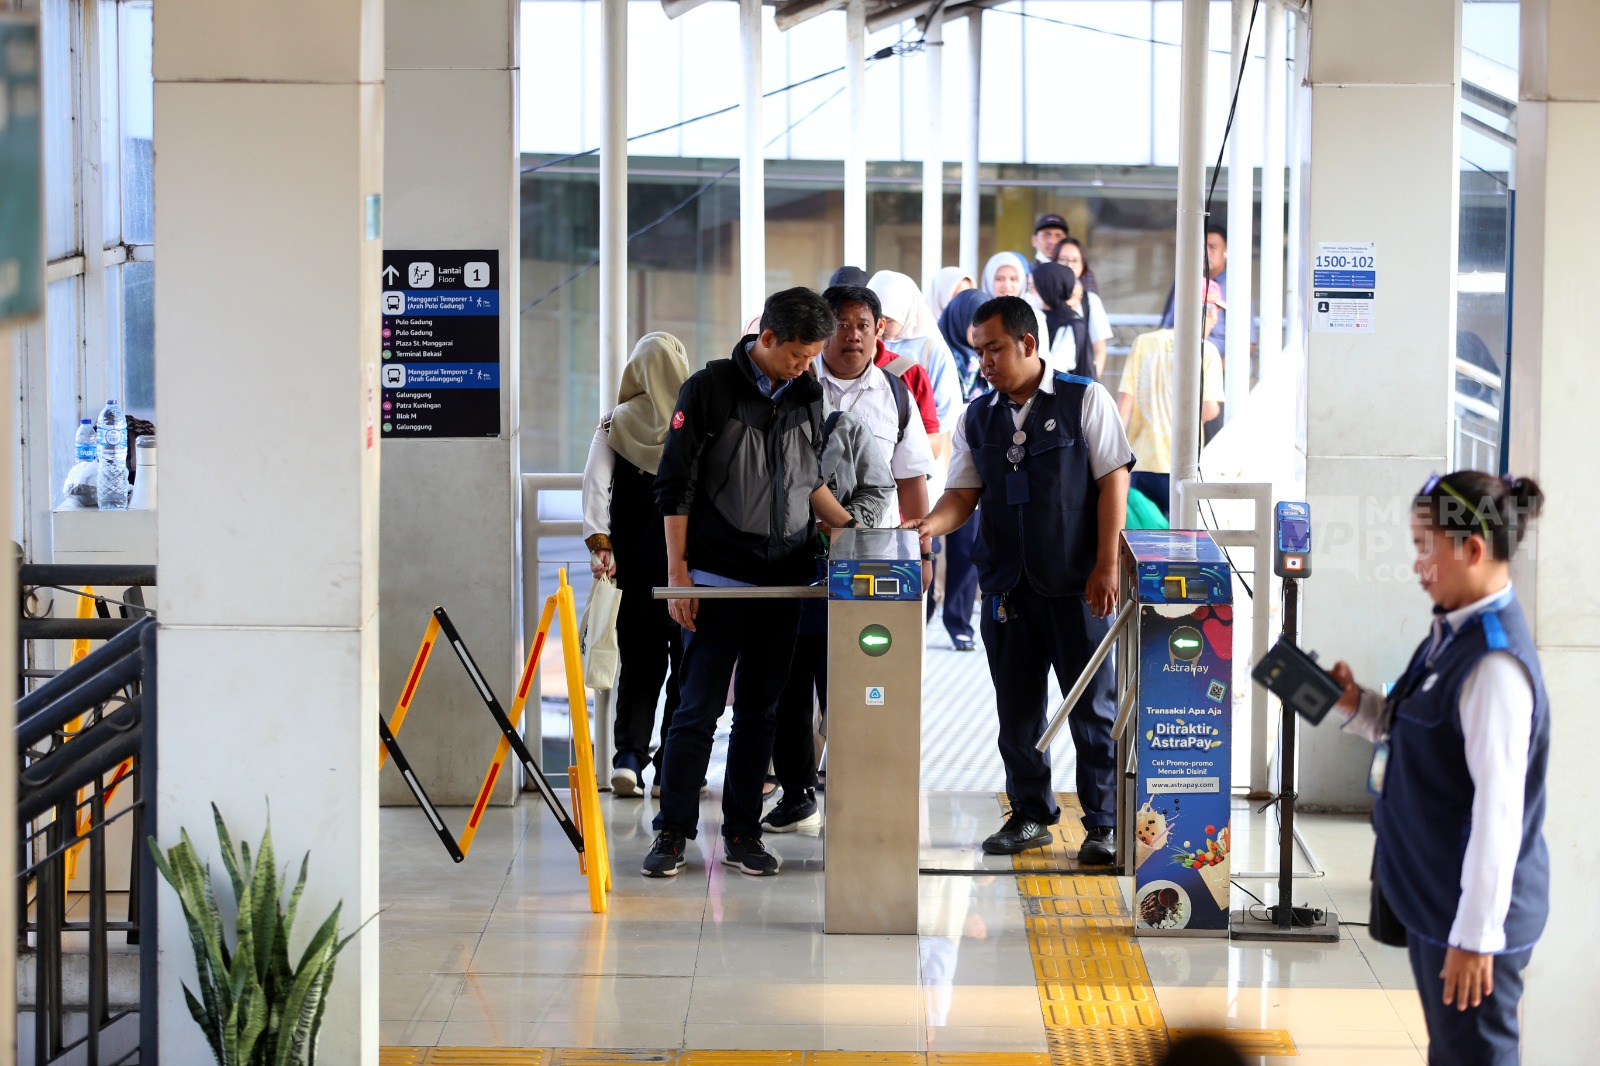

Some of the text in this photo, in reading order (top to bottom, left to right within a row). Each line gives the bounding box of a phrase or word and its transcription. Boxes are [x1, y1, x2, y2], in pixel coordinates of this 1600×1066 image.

[1316, 256, 1374, 268] 1500-102
[473, 269, 481, 281] 1
[1188, 707, 1206, 715] Apa
[1207, 707, 1222, 715] Aja
[1156, 723, 1212, 735] Ditraktir
[1151, 736, 1212, 750] AstraPay
